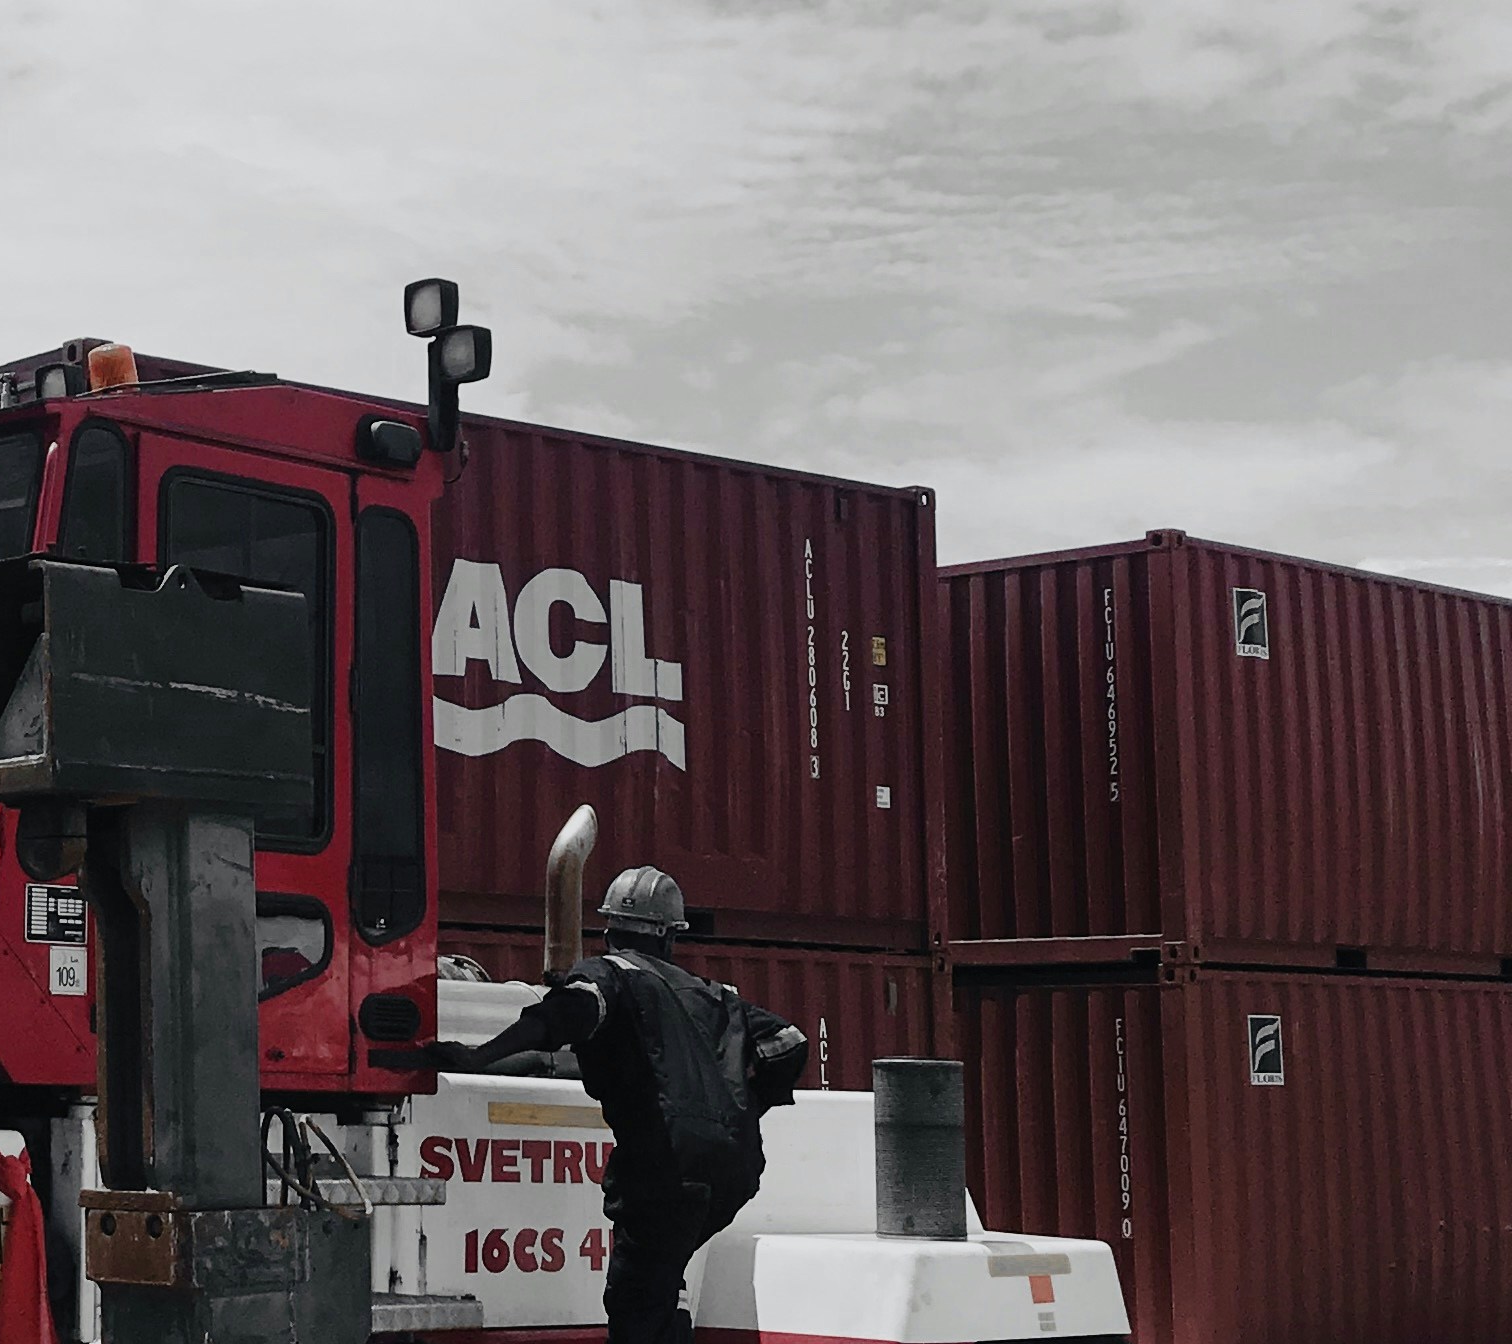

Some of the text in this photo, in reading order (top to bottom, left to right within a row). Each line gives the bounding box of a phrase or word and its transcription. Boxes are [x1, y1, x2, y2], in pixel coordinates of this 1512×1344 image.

[432, 558, 683, 700] ACL
[805, 539, 819, 779] ACLU 280608 3
[1104, 589, 1115, 661] FCIU
[841, 630, 850, 711] 22G1
[1106, 666, 1118, 775] 646952
[56, 966, 76, 987] 109
[819, 1017, 829, 1091] ACL
[1115, 1018, 1125, 1092] FCIU
[1118, 1098, 1130, 1210] 647009
[464, 1227, 615, 1274] 16CS 4
